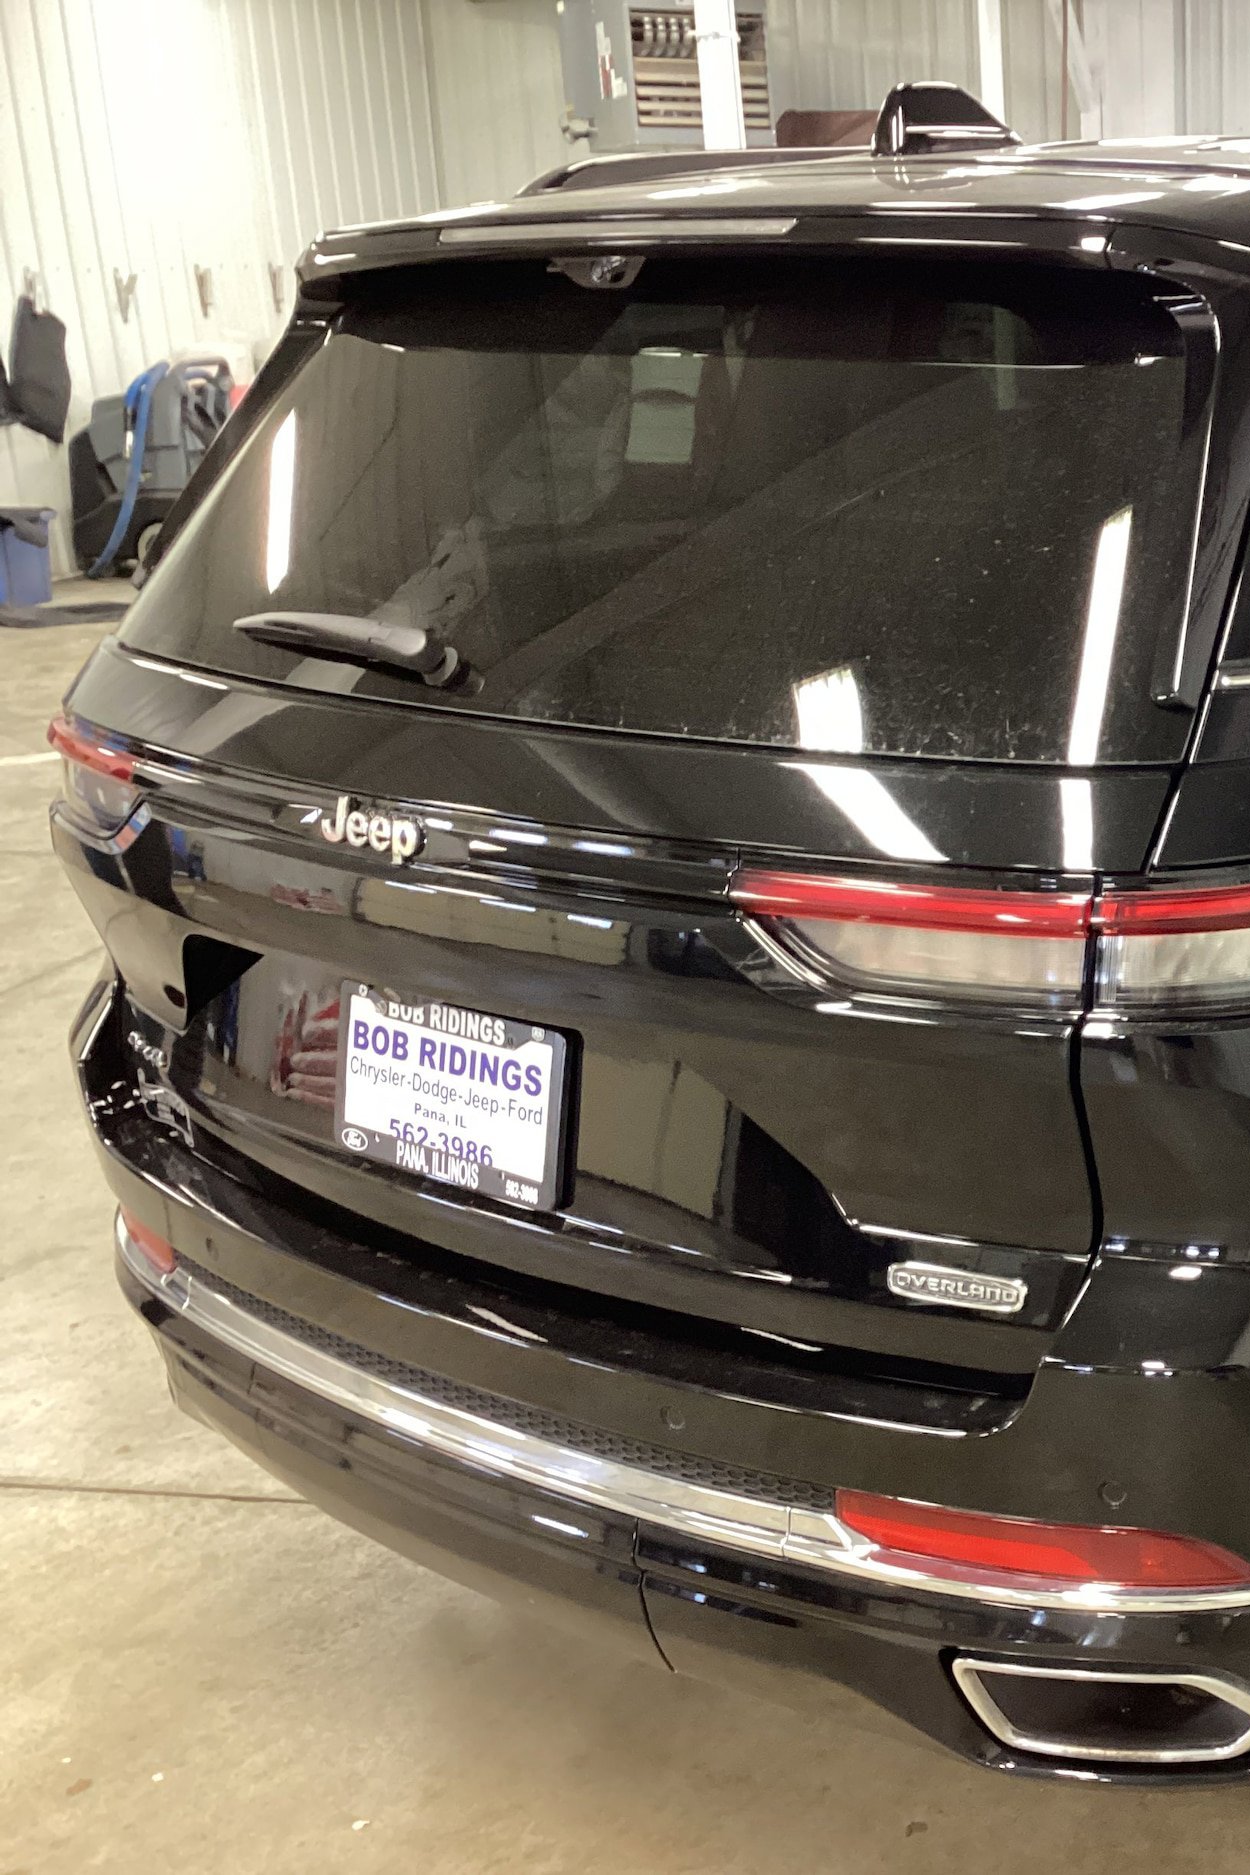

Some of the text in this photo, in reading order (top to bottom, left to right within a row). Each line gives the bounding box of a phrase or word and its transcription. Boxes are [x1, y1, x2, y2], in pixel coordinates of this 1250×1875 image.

[321, 795, 418, 865] Jeep
[388, 1001, 506, 1046] BOB RIDINGS
[353, 1019, 543, 1097] BOB RIDINGS
[350, 1055, 543, 1126] Chrysler-Dodge-Jeep-Ford
[414, 1102, 468, 1129] Pana, IL
[389, 1118, 493, 1167] 562-3986
[431, 1145, 480, 1190] ILLINOIS
[896, 1272, 1018, 1302] OVERLAND
